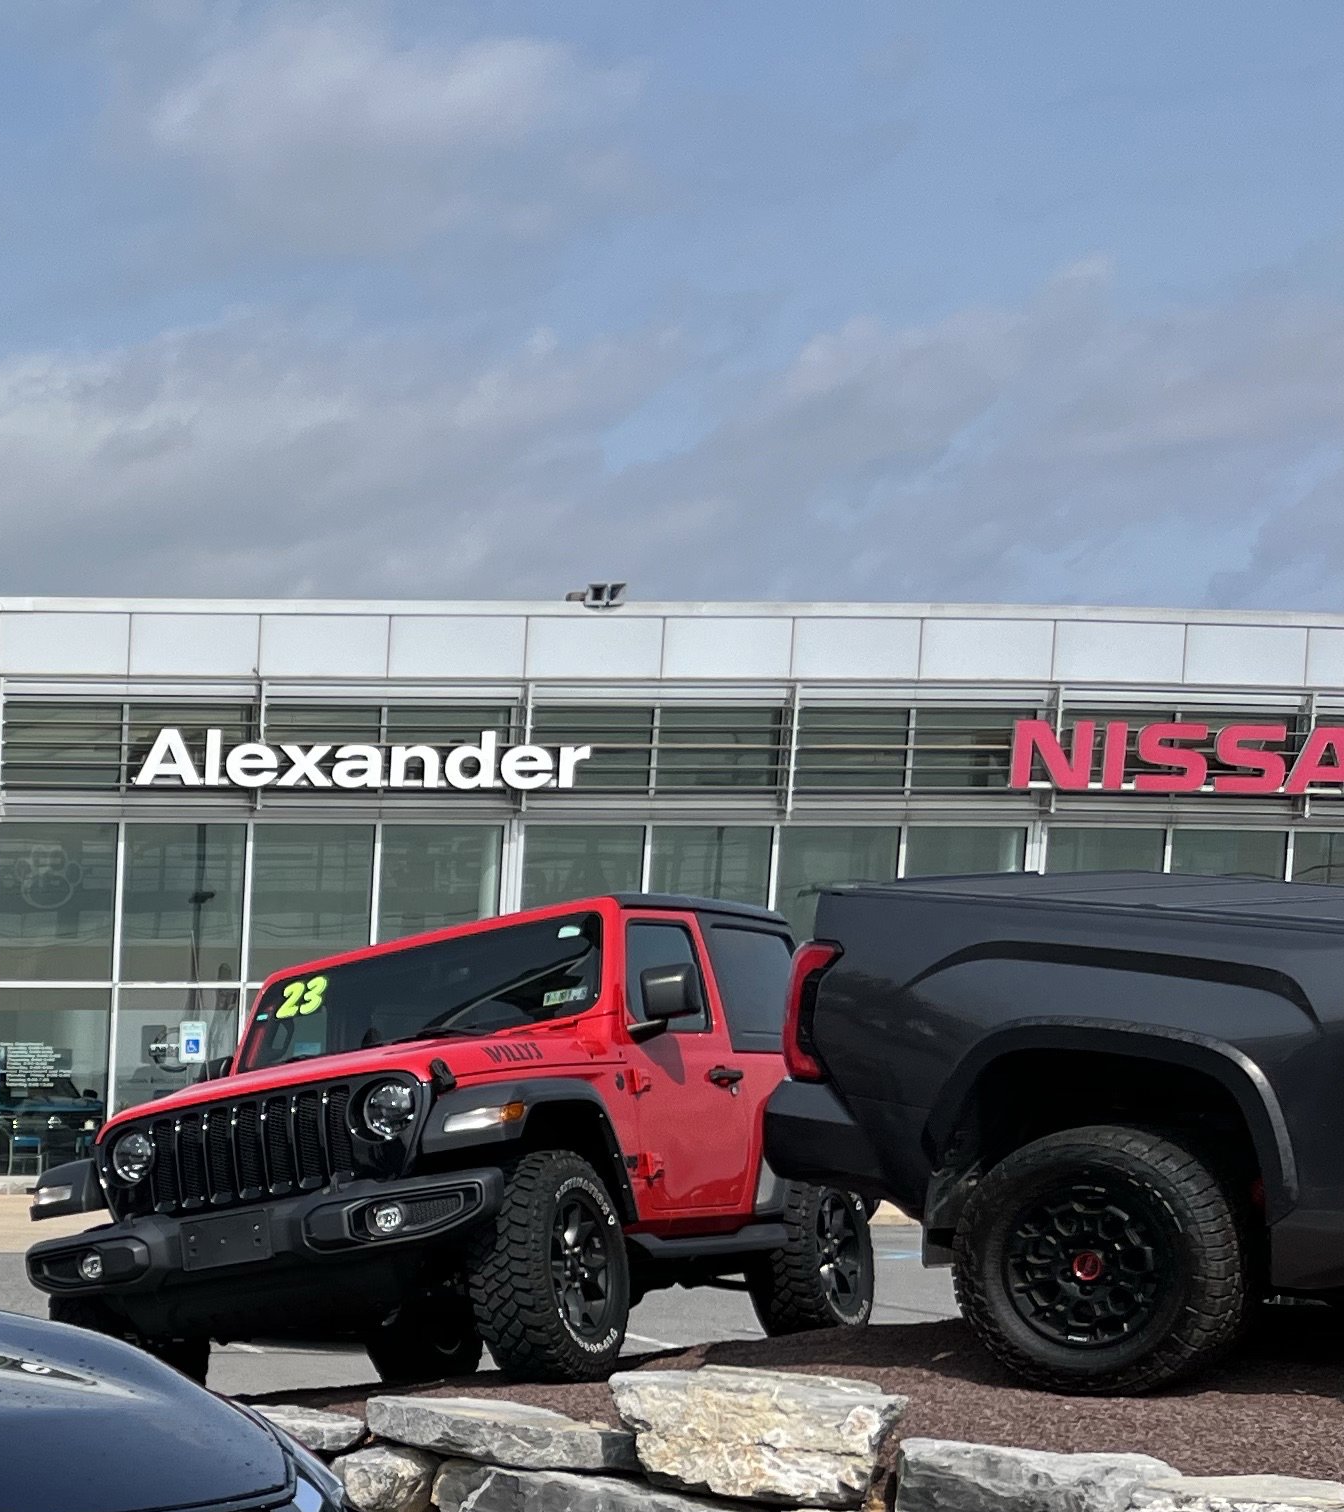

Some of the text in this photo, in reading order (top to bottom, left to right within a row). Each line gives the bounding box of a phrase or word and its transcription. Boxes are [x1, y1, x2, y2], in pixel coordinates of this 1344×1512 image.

[133, 728, 591, 789] Alexander
[276, 975, 329, 1019] 23
[481, 1042, 543, 1063] WILLYS
